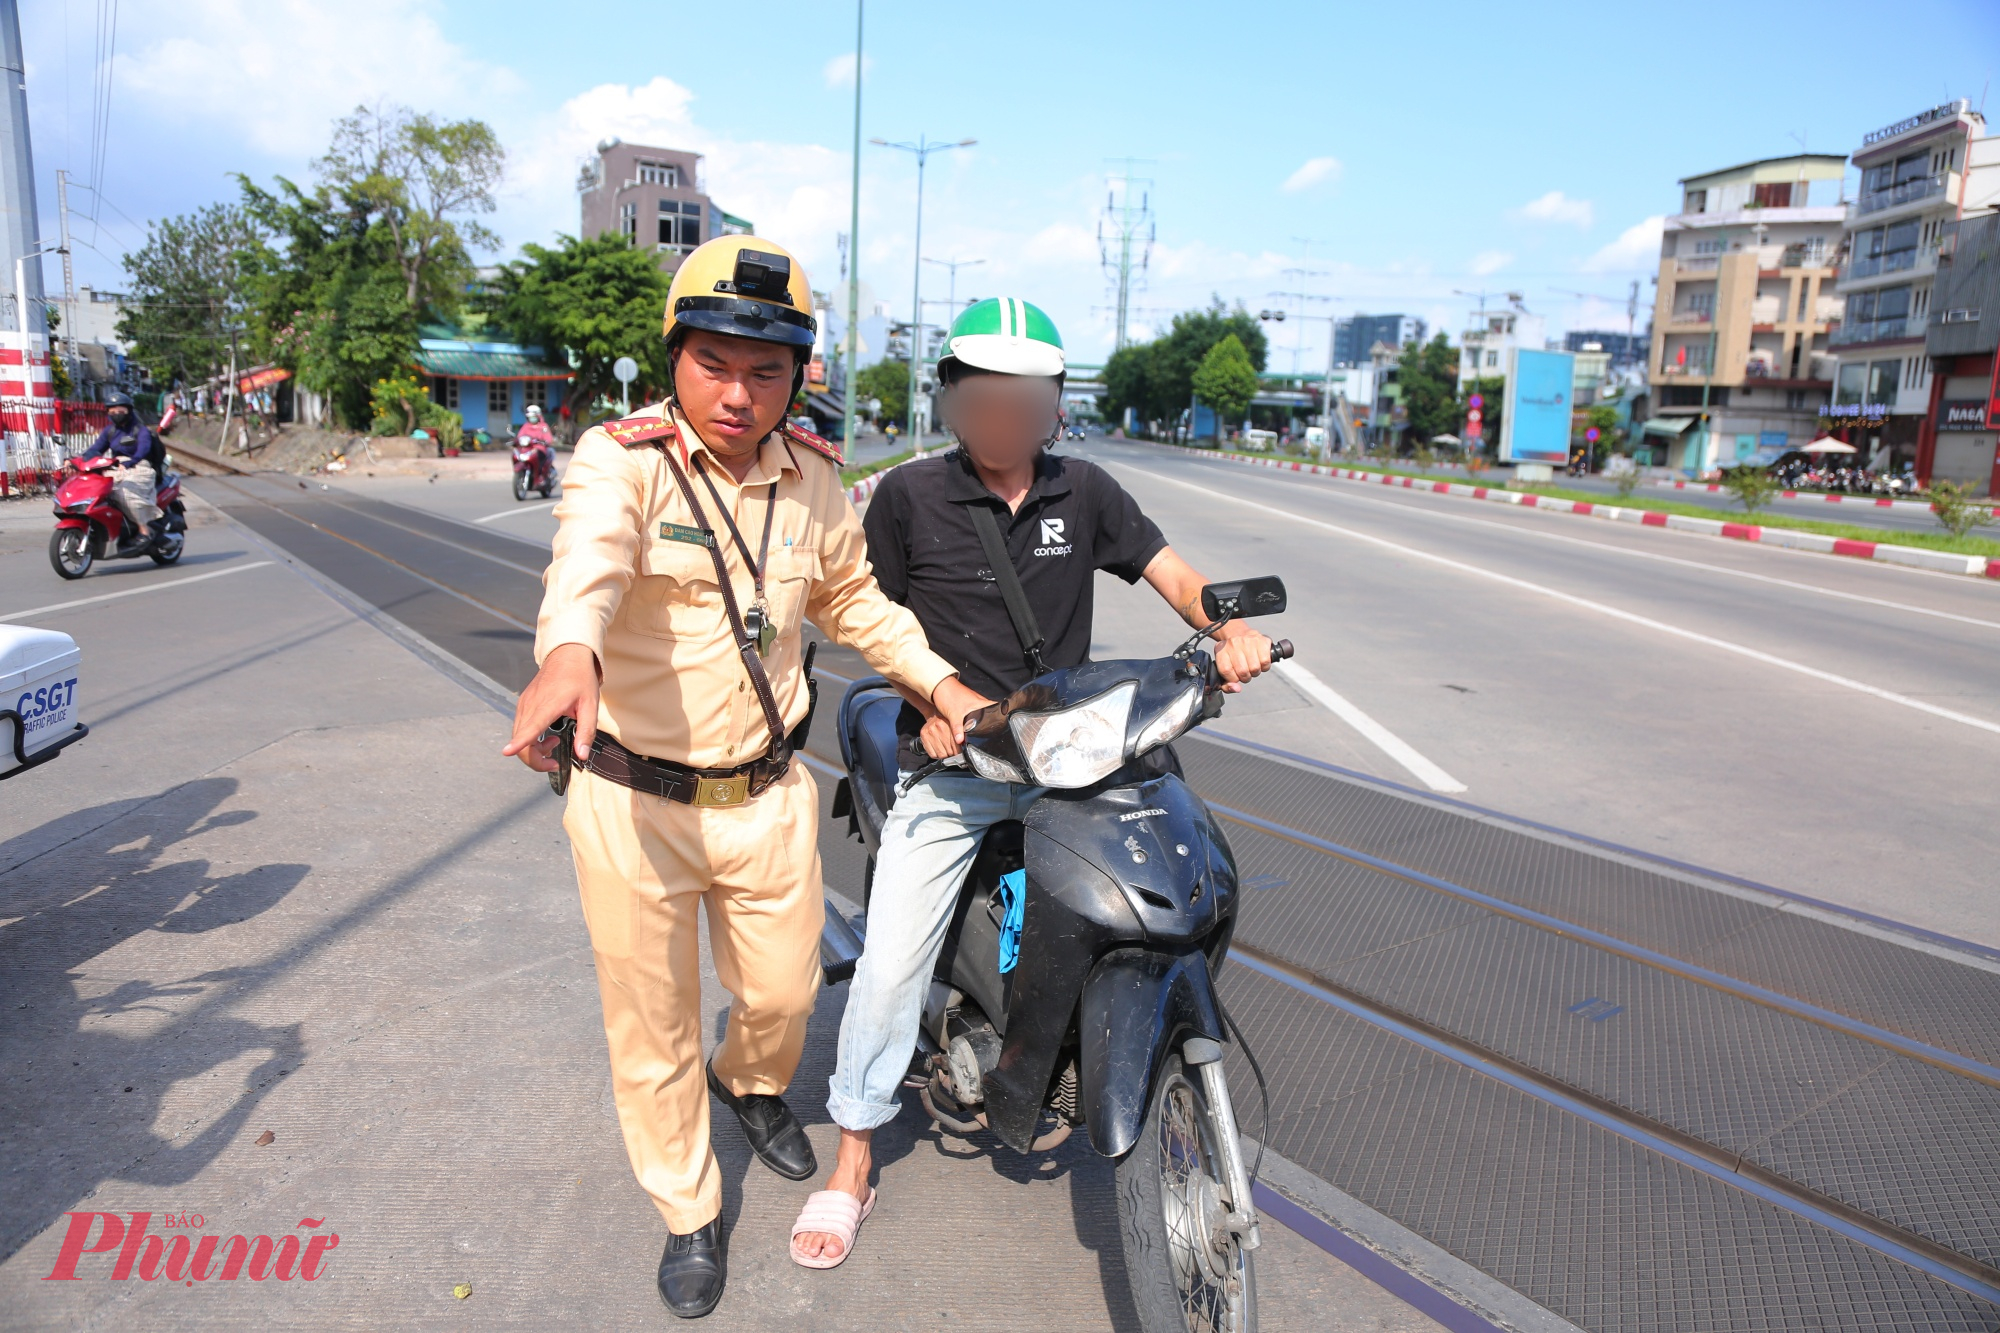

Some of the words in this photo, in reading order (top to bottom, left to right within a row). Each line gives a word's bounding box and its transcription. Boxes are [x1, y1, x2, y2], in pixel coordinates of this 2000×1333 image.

[1034, 544, 1072, 557] concept
[16, 678, 77, 721] C.S.G.T
[24, 716, 45, 734] RAFFIC
[46, 709, 67, 727] POLICE
[1119, 808, 1168, 823] HONDA
